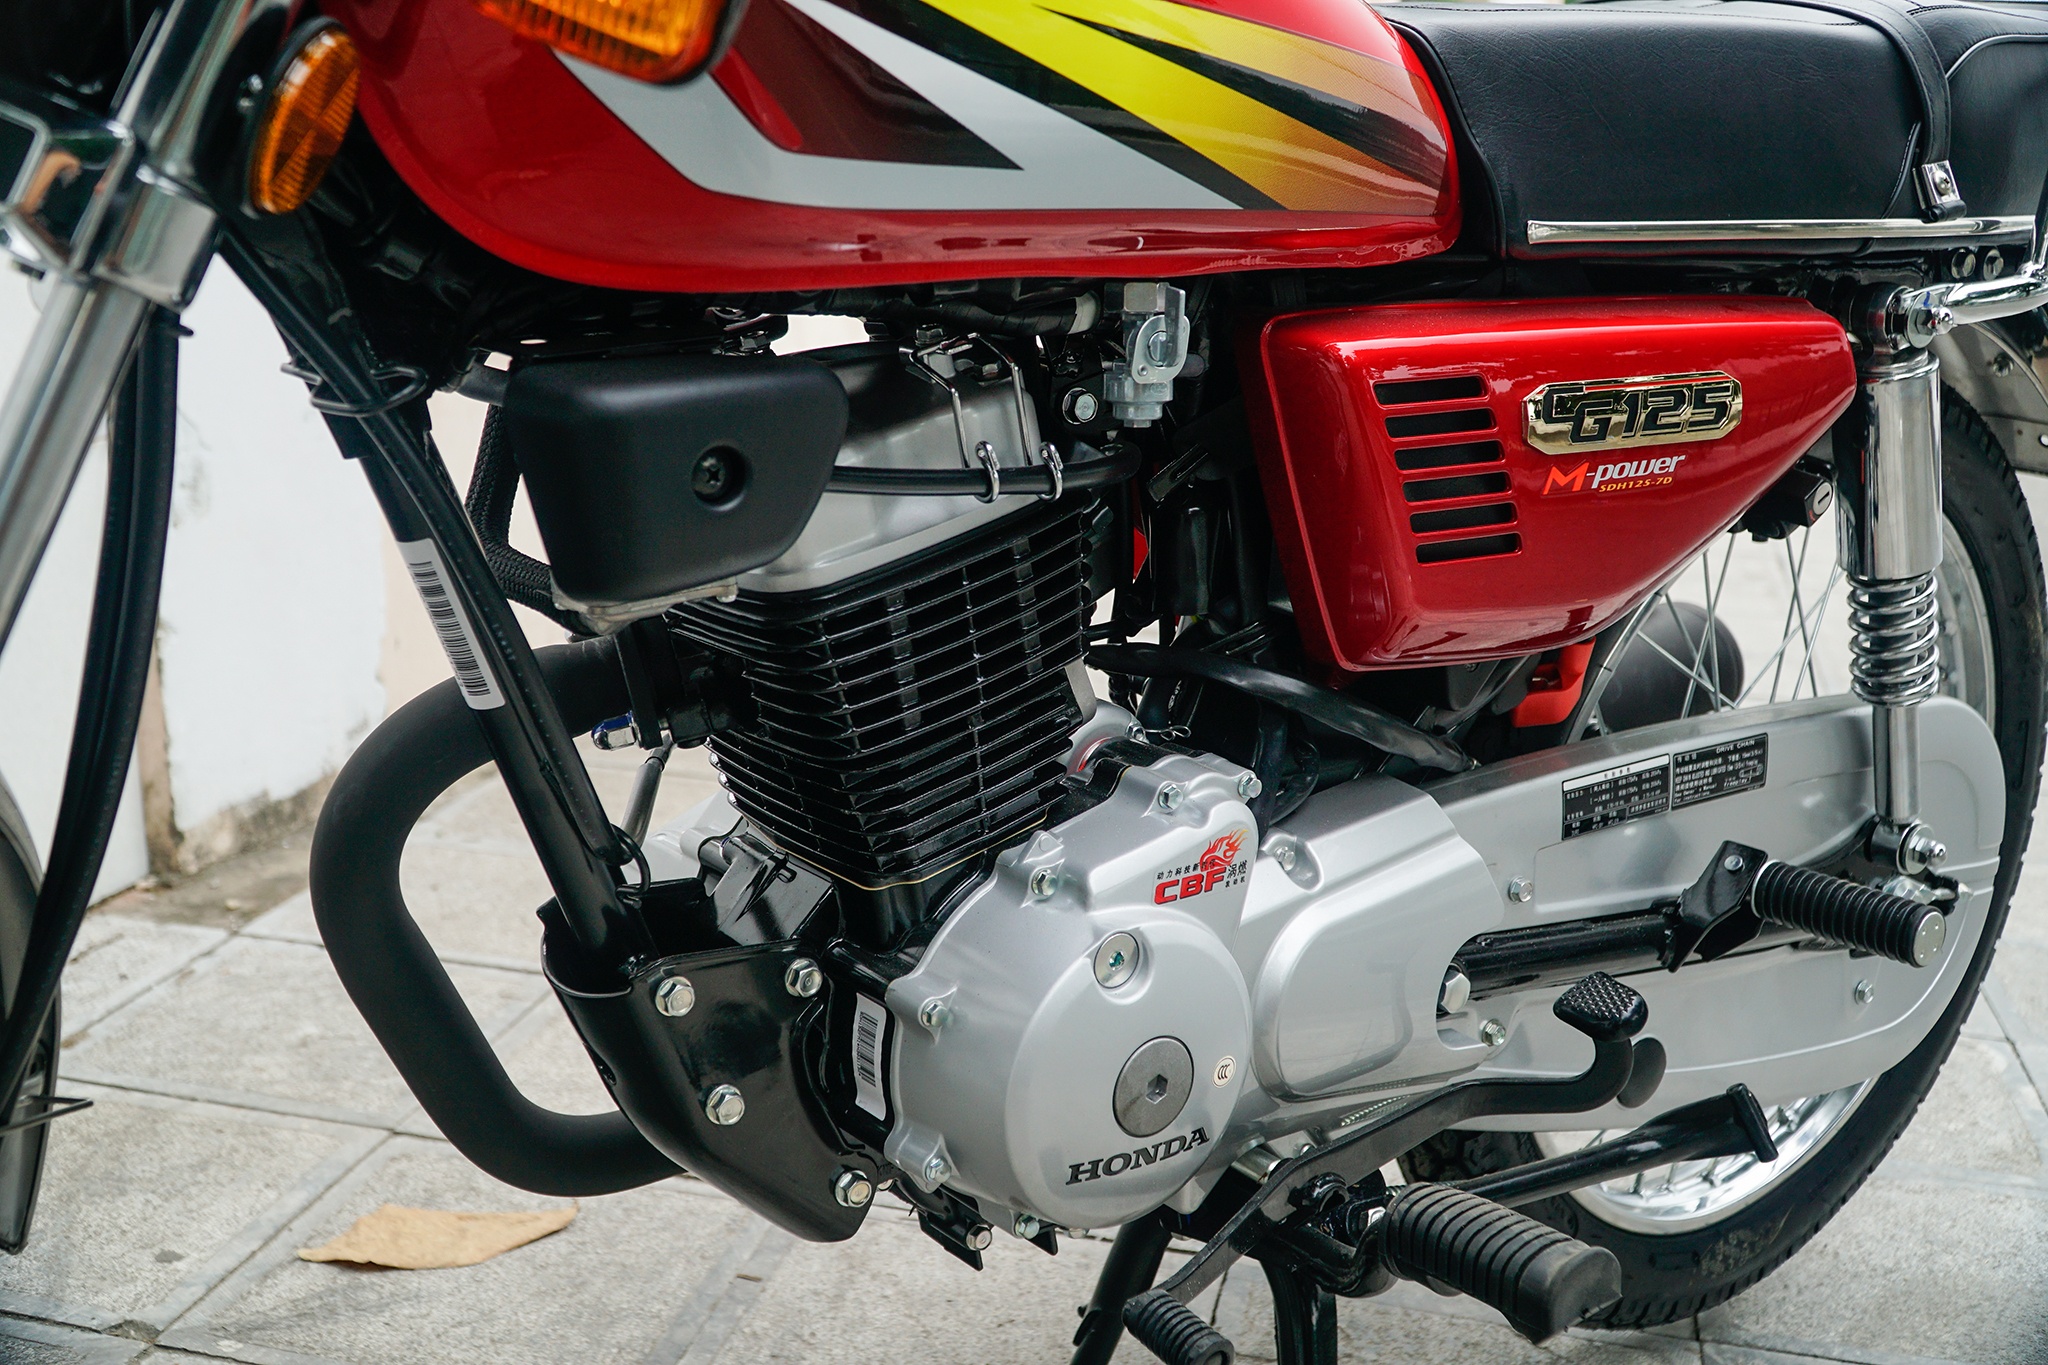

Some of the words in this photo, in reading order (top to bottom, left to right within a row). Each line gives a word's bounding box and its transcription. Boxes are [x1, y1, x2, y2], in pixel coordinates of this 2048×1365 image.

[1541, 384, 1735, 444] CG125
[1543, 455, 1686, 495] M-power
[1716, 744, 1734, 754] DRIVE
[1737, 740, 1755, 749] CHAIN
[1154, 866, 1227, 905] CBF
[1065, 1126, 1211, 1186] HONDA
